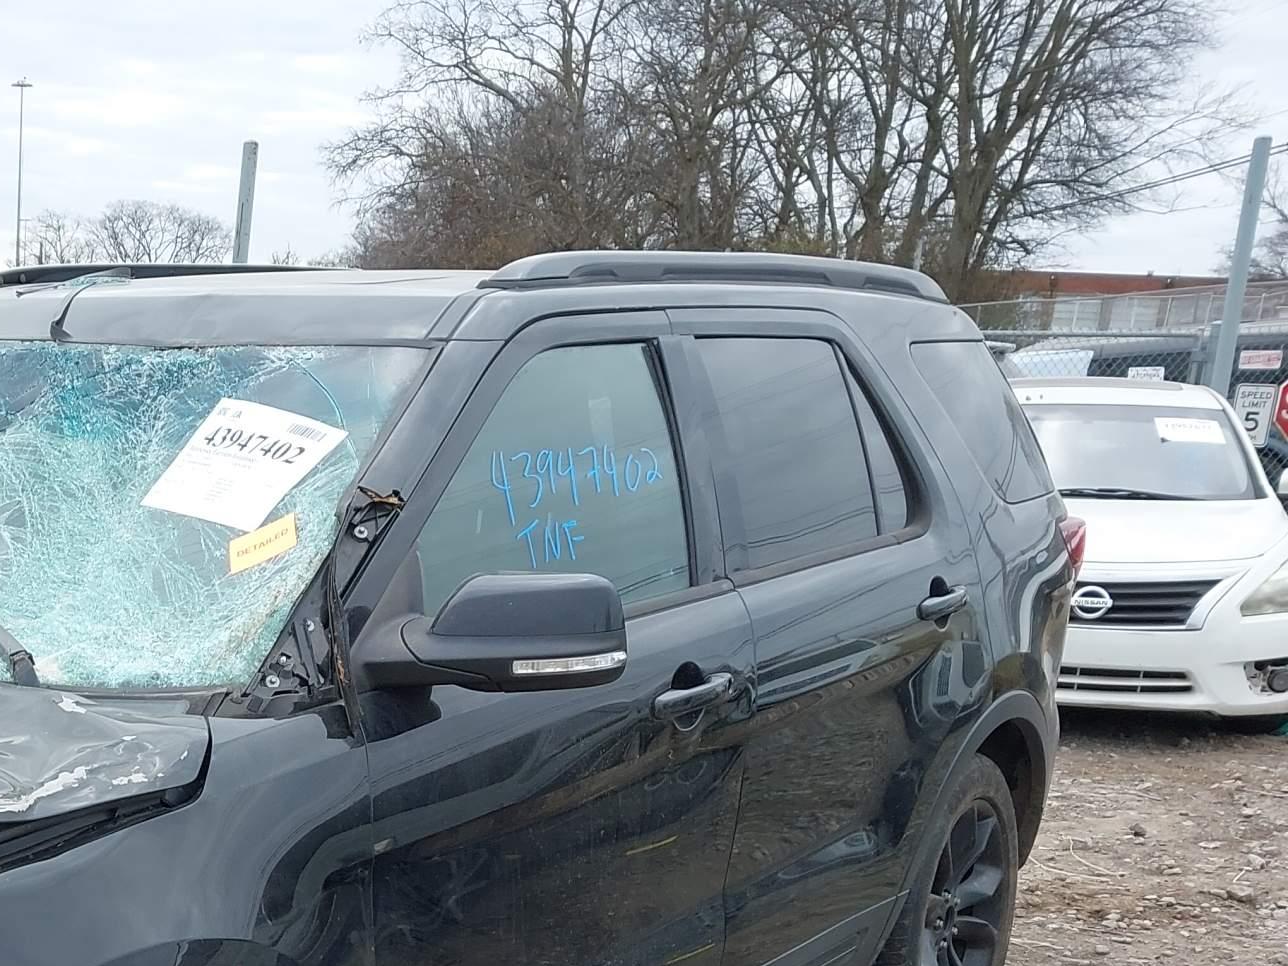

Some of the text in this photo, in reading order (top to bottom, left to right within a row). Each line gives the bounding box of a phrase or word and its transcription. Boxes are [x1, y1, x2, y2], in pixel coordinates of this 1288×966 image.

[1240, 391, 1272, 400] SPEED
[1244, 411, 1260, 432] 5
[204, 426, 306, 465] 43947402
[490, 444, 663, 526] 43947402
[516, 512, 585, 569] TNF
